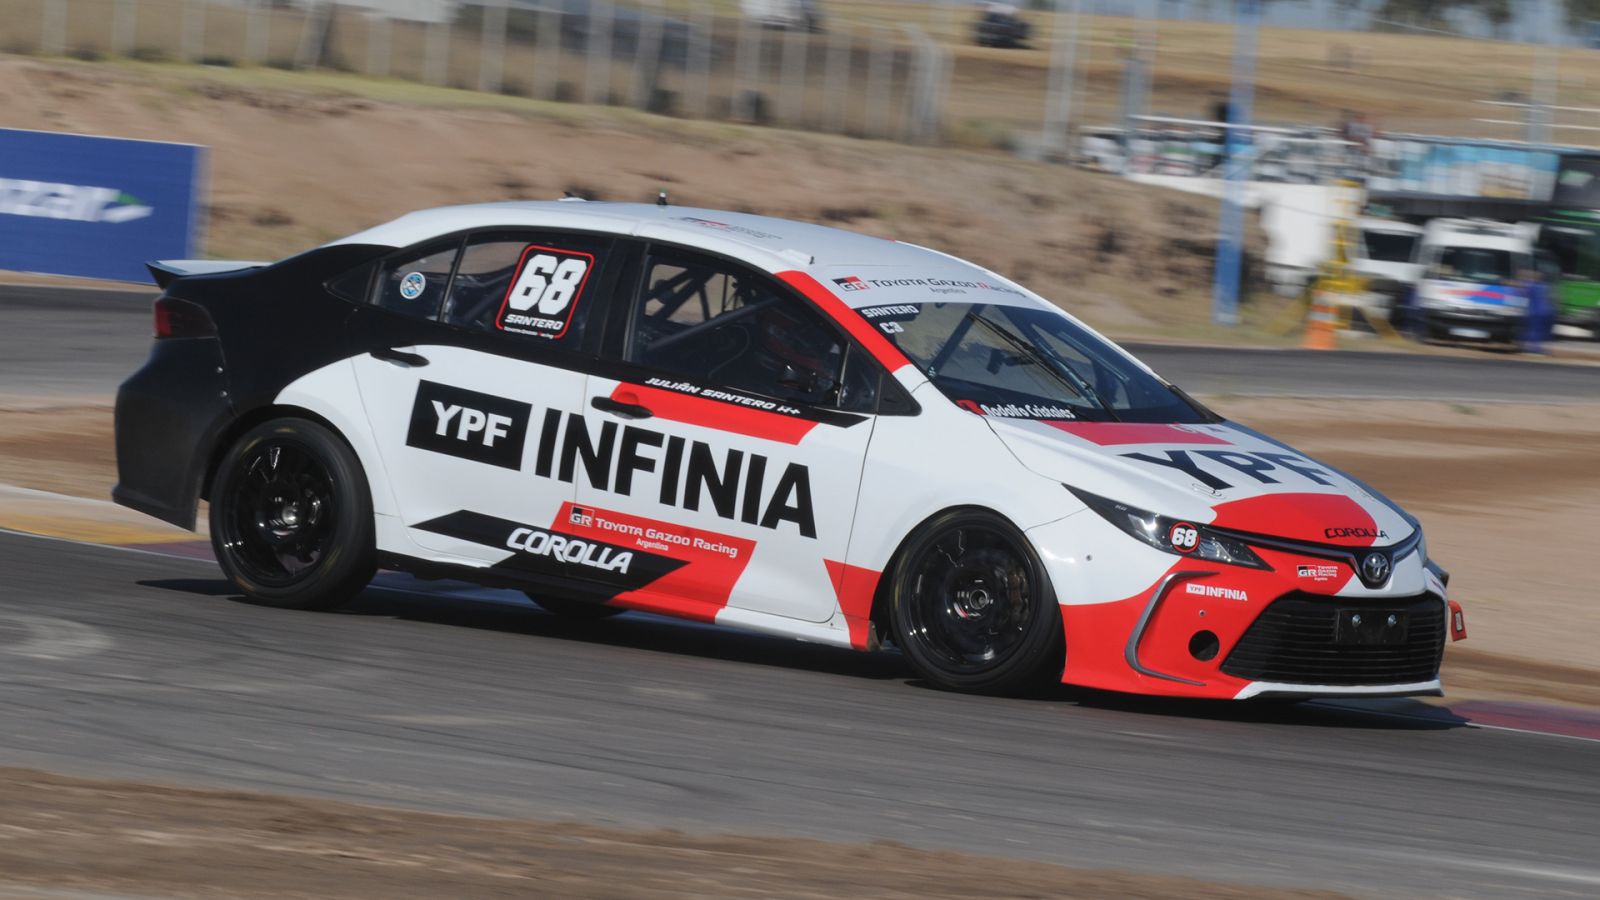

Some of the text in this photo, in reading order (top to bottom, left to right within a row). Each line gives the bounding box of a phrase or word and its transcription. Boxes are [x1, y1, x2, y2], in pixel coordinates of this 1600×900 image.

[509, 254, 587, 315] 68
[861, 304, 920, 319] SANTERO
[504, 314, 564, 330] SANTERO
[879, 322, 904, 334] C3
[645, 377, 701, 394] JULIÁN
[701, 389, 776, 410] SANTERO
[431, 399, 818, 539] YPF INFINIA
[1118, 450, 1338, 490] YPF
[570, 513, 593, 527] GR
[693, 538, 738, 558] Racing
[1171, 527, 1198, 547] 68
[1324, 527, 1389, 540] COROLLA
[506, 527, 634, 574] COROLLA
[636, 538, 669, 551] Argentina
[1206, 586, 1248, 601] INFINIA
